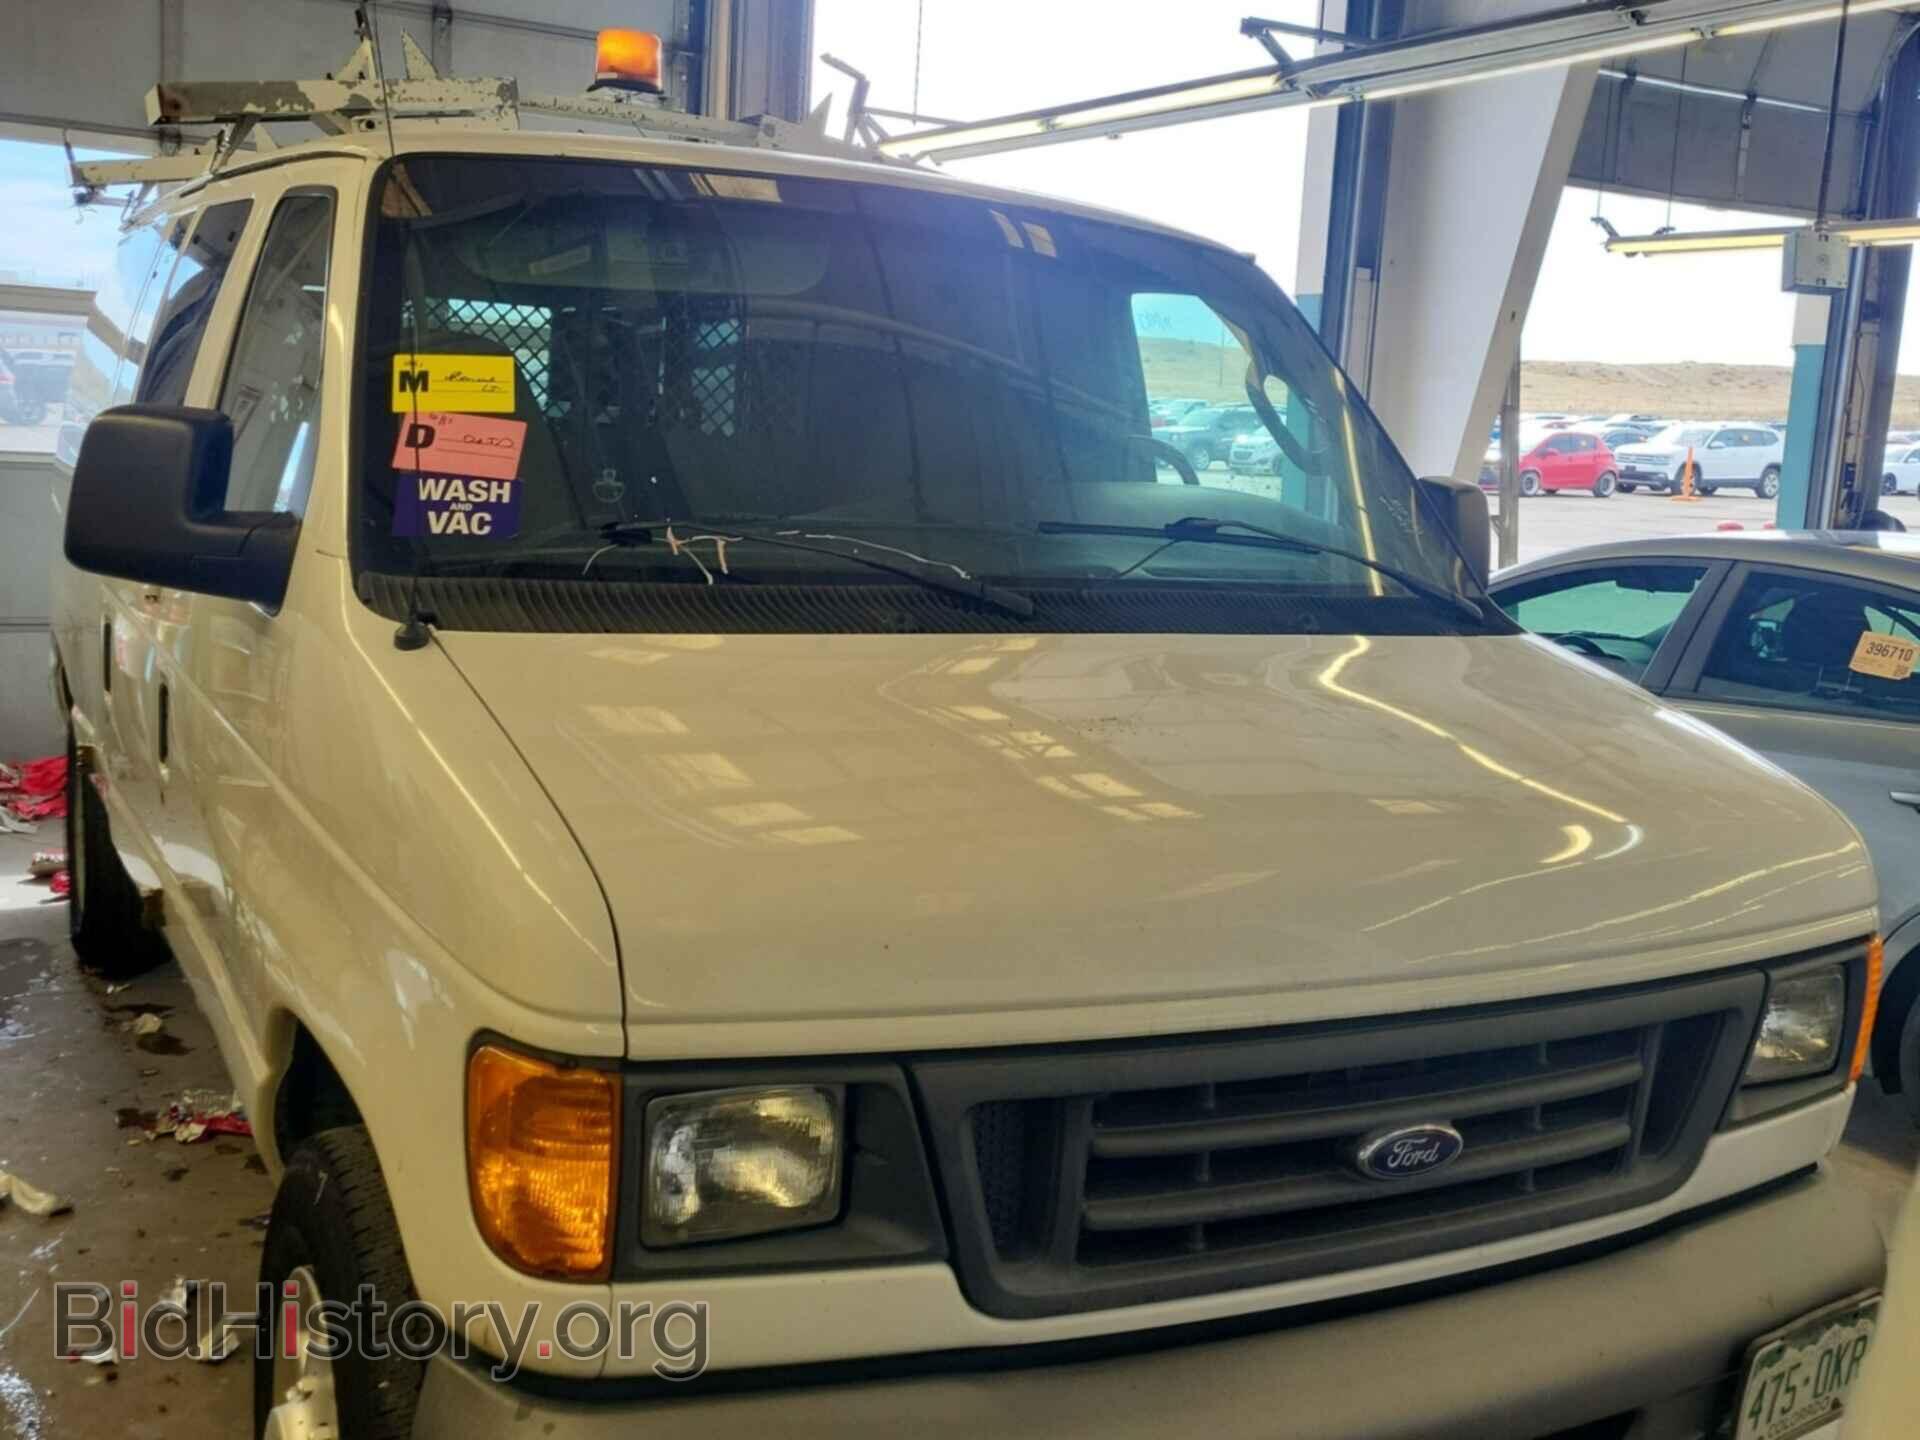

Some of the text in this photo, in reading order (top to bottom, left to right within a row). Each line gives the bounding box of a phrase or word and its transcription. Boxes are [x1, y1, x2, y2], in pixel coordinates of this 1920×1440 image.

[398, 370, 429, 393] M
[404, 423, 436, 449] D
[418, 478, 512, 504] WASH
[449, 502, 473, 511] AND
[427, 511, 492, 535] VAC
[1865, 641, 1914, 662] 396710
[1387, 1137, 1441, 1168] Ford
